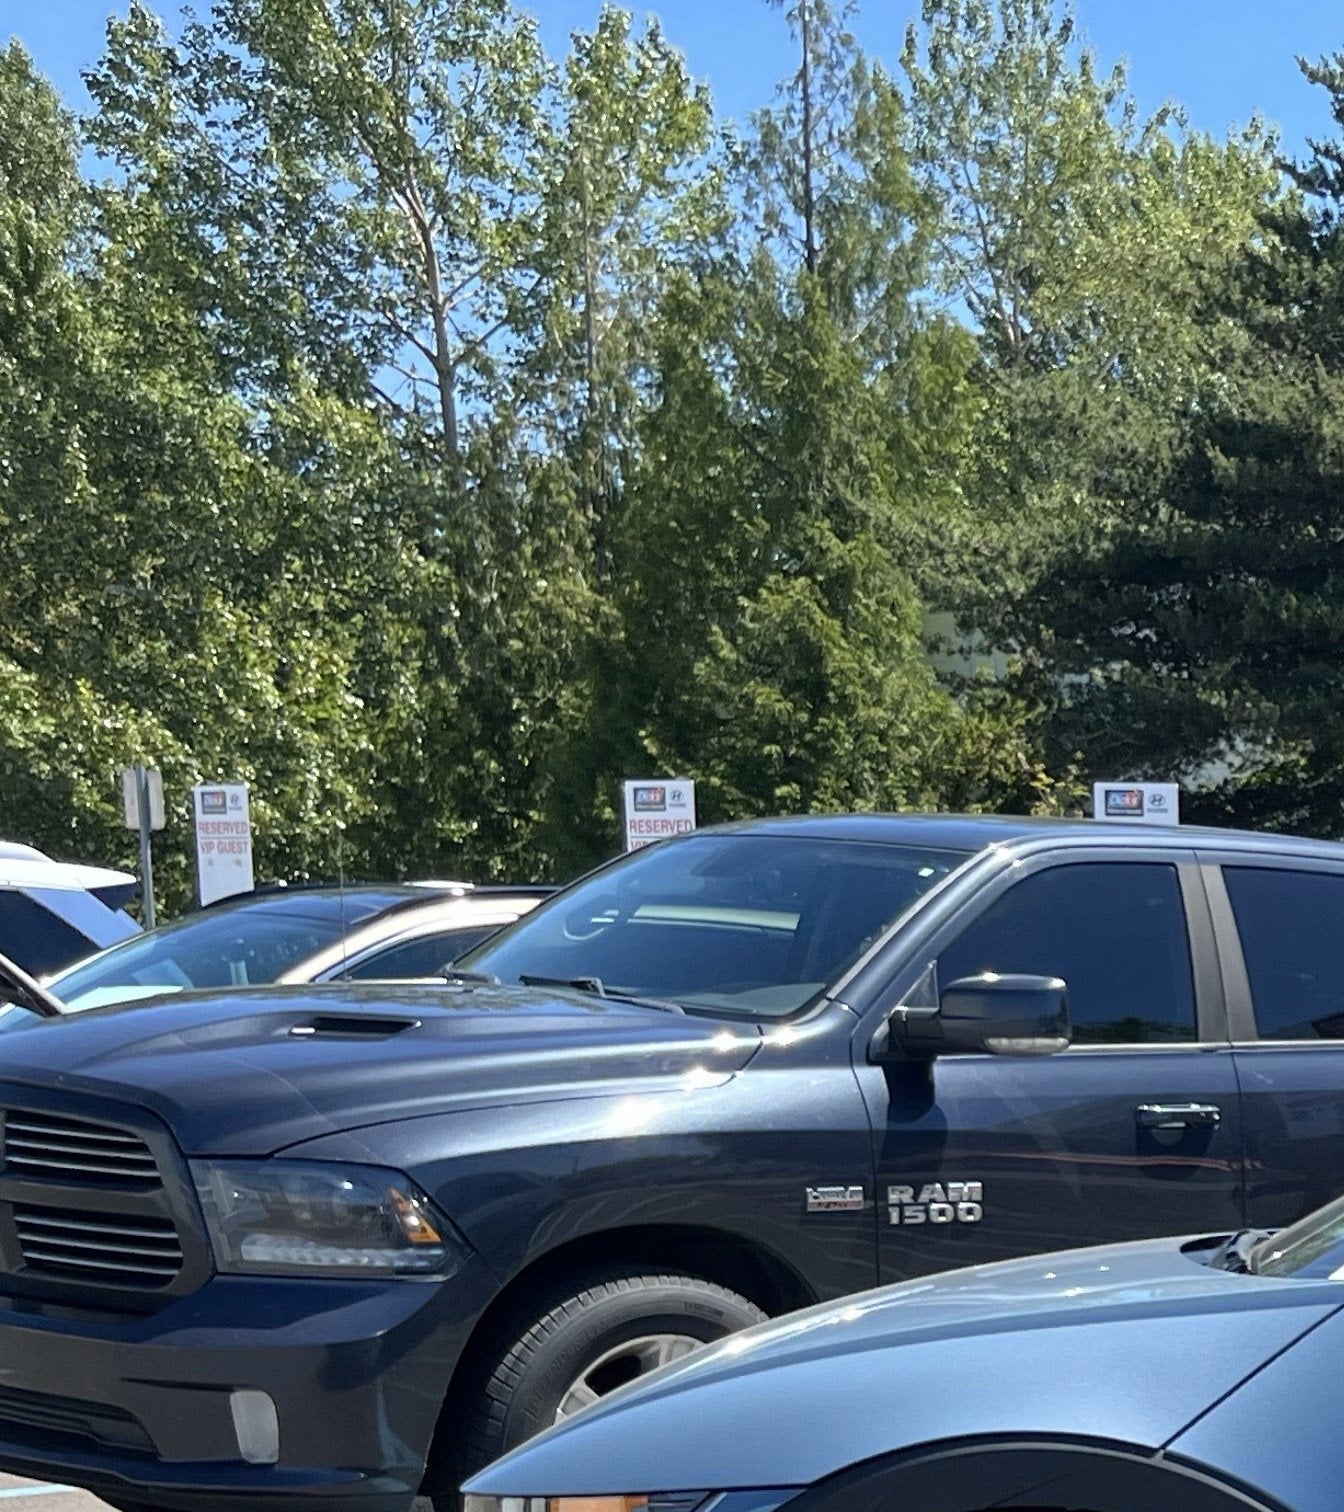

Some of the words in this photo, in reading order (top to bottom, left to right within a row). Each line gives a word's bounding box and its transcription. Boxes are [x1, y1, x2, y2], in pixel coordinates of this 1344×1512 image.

[629, 819, 692, 833] RESERVED
[887, 1181, 983, 1204] RAM
[887, 1202, 983, 1225] 1500
